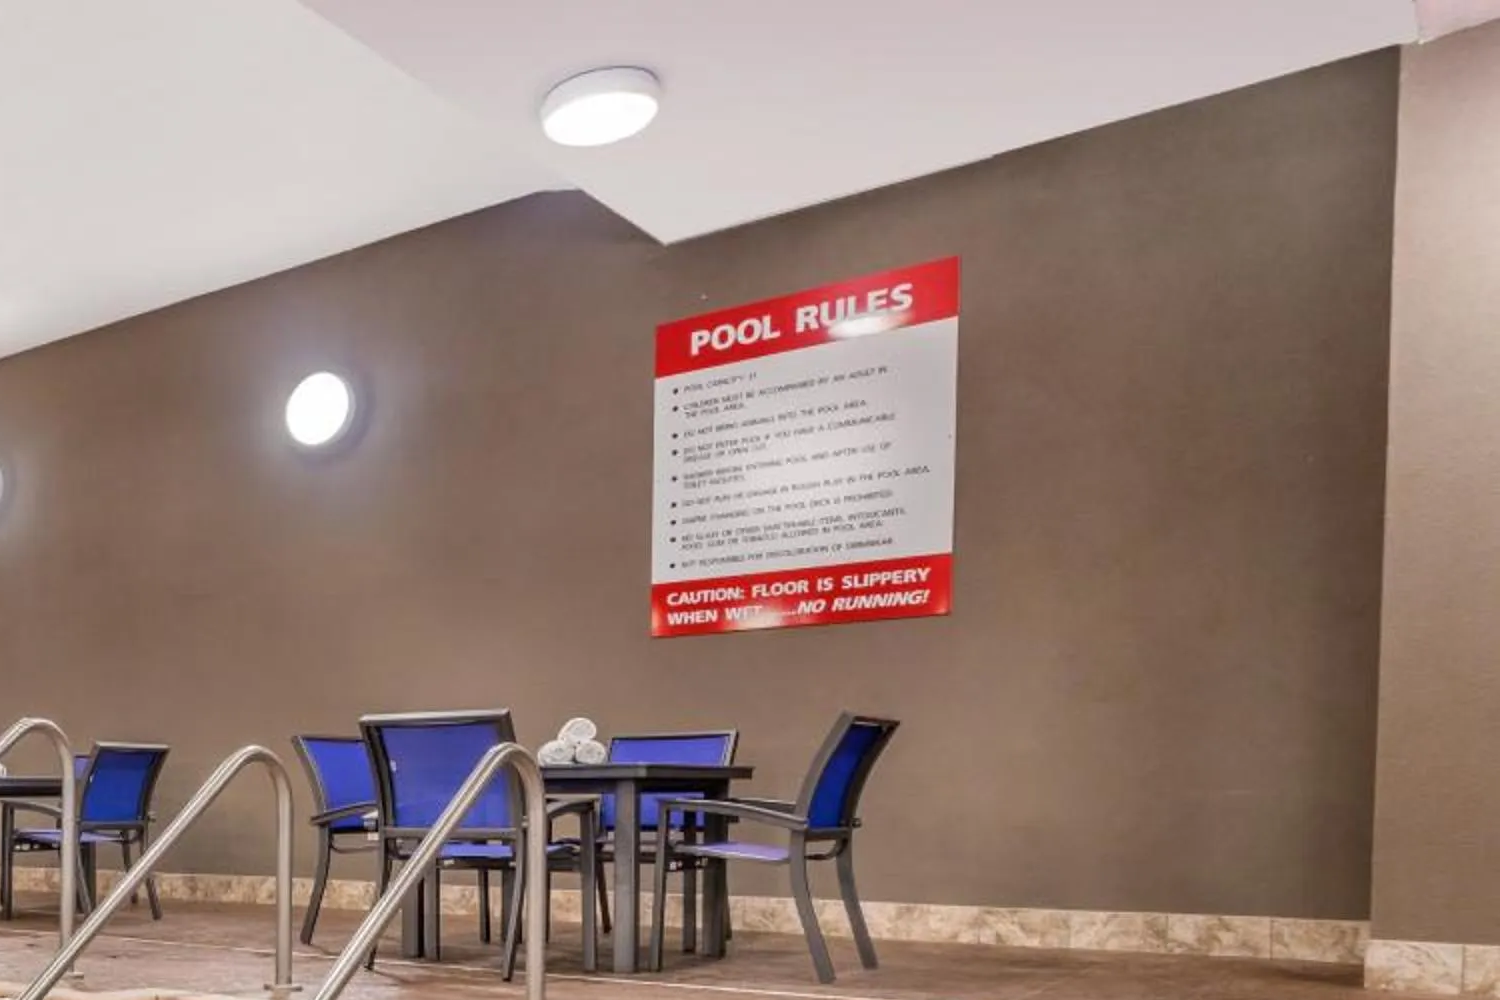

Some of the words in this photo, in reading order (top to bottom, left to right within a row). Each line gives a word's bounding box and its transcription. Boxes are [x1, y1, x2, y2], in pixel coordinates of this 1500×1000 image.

[690, 315, 780, 356] POOL
[795, 283, 913, 332] RULES
[666, 587, 746, 606] CAUTION:
[751, 579, 809, 598] FLOOR
[816, 577, 834, 593] IS
[841, 567, 931, 591] SLIPPERY
[667, 611, 719, 626] WHEN
[831, 590, 931, 613] RUNNING!
